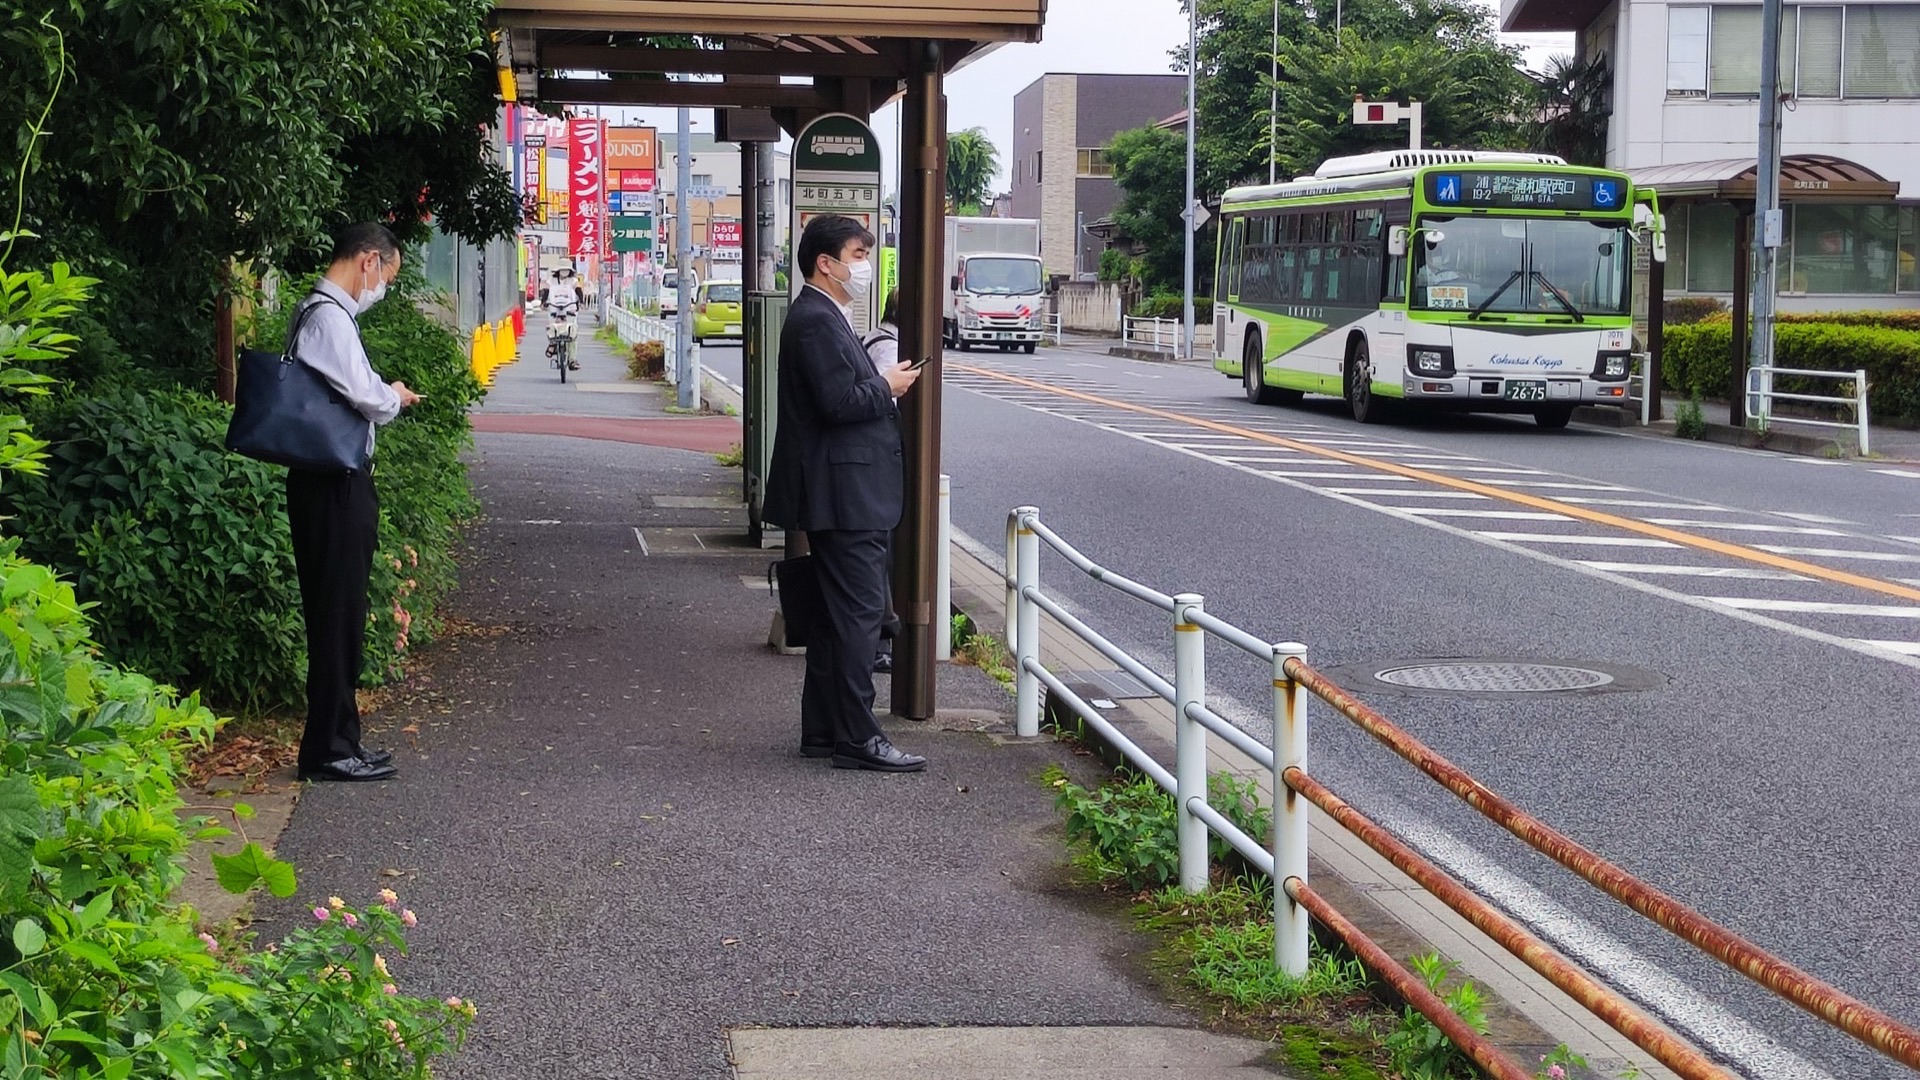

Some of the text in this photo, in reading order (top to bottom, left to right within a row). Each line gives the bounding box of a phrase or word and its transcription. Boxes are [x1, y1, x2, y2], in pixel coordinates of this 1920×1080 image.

[608, 140, 649, 157] OUND1
[1476, 175, 1490, 189] 浦
[1514, 177, 1576, 195] 浦和駅西口
[1793, 180, 1829, 189] 北町五丁目
[802, 187, 873, 200] 北町五丁目
[1511, 194, 1554, 203] URAWA STA.
[612, 228, 653, 239] ルフ練習場
